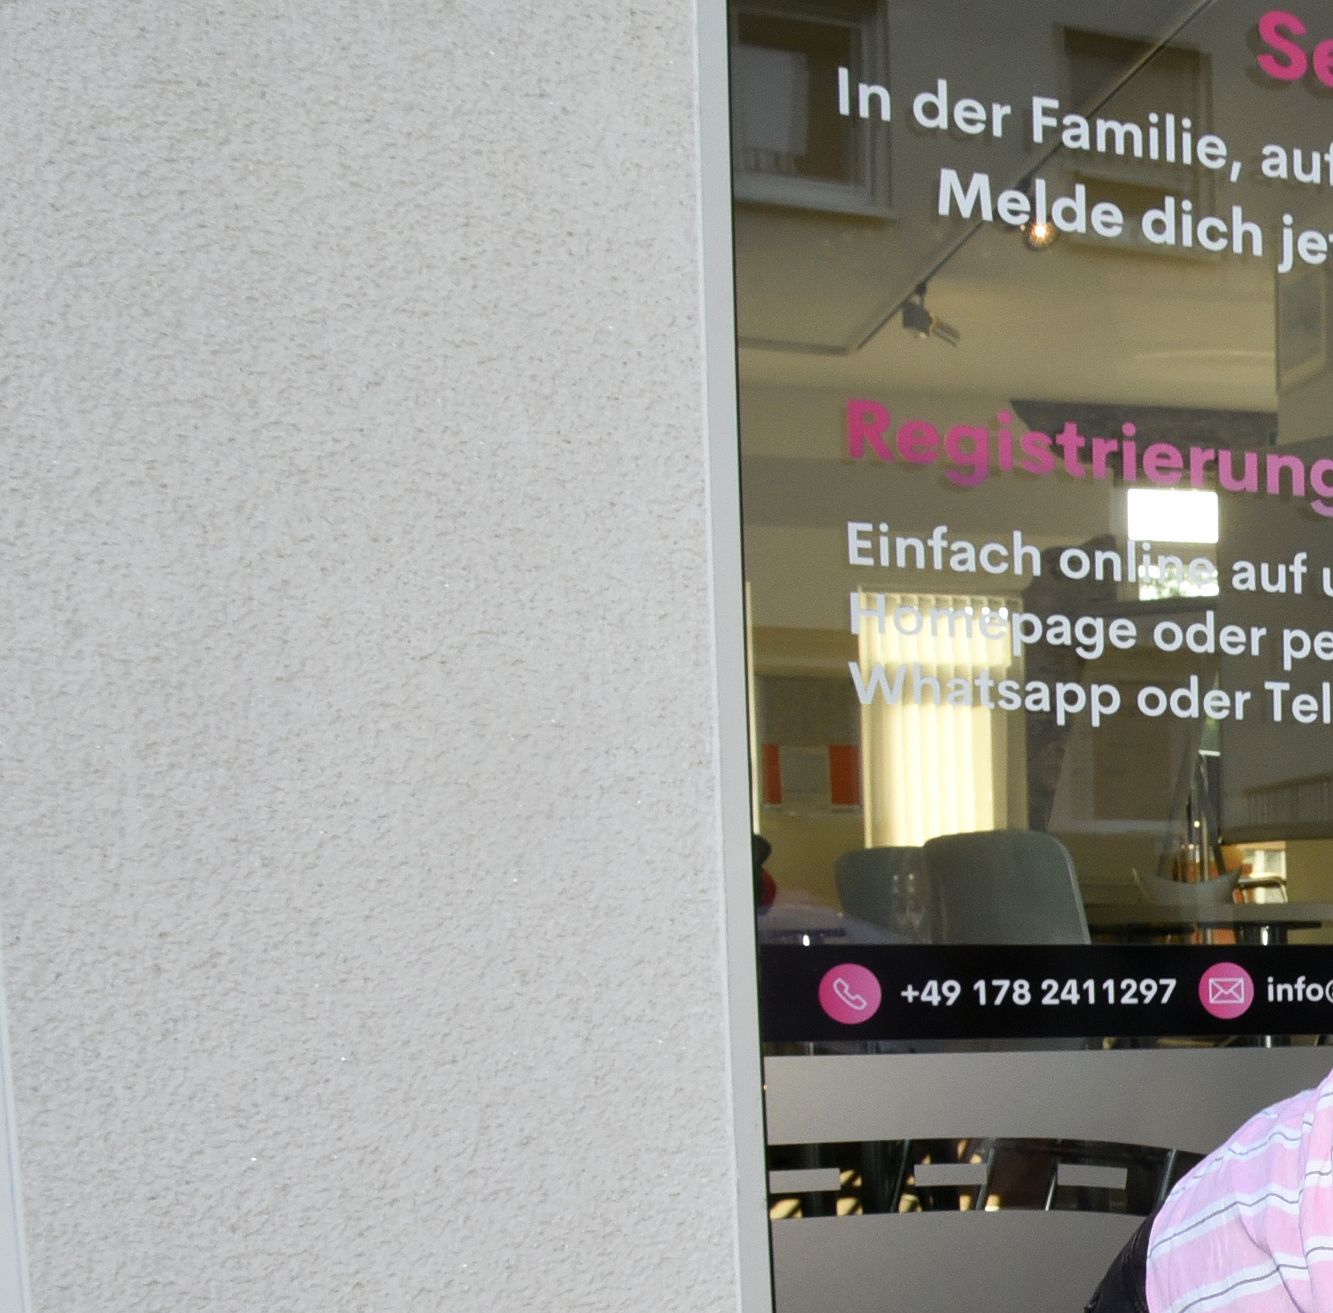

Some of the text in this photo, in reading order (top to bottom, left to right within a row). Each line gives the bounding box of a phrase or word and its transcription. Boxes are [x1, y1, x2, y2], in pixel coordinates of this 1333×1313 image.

[837, 66, 891, 122] In
[912, 78, 1011, 138] der
[1031, 95, 1241, 183] Familie,
[937, 167, 1124, 238] Melde
[1141, 195, 1263, 257] dich
[847, 521, 1042, 578] Einfach
[1059, 540, 1218, 587] online
[1231, 552, 1309, 595] auf
[850, 591, 1137, 662] Homepage
[1153, 611, 1267, 657] oder
[849, 661, 1121, 727] Whatsapp
[1136, 676, 1252, 722] oder
[900, 977, 1177, 1008] +49 178 2411297
